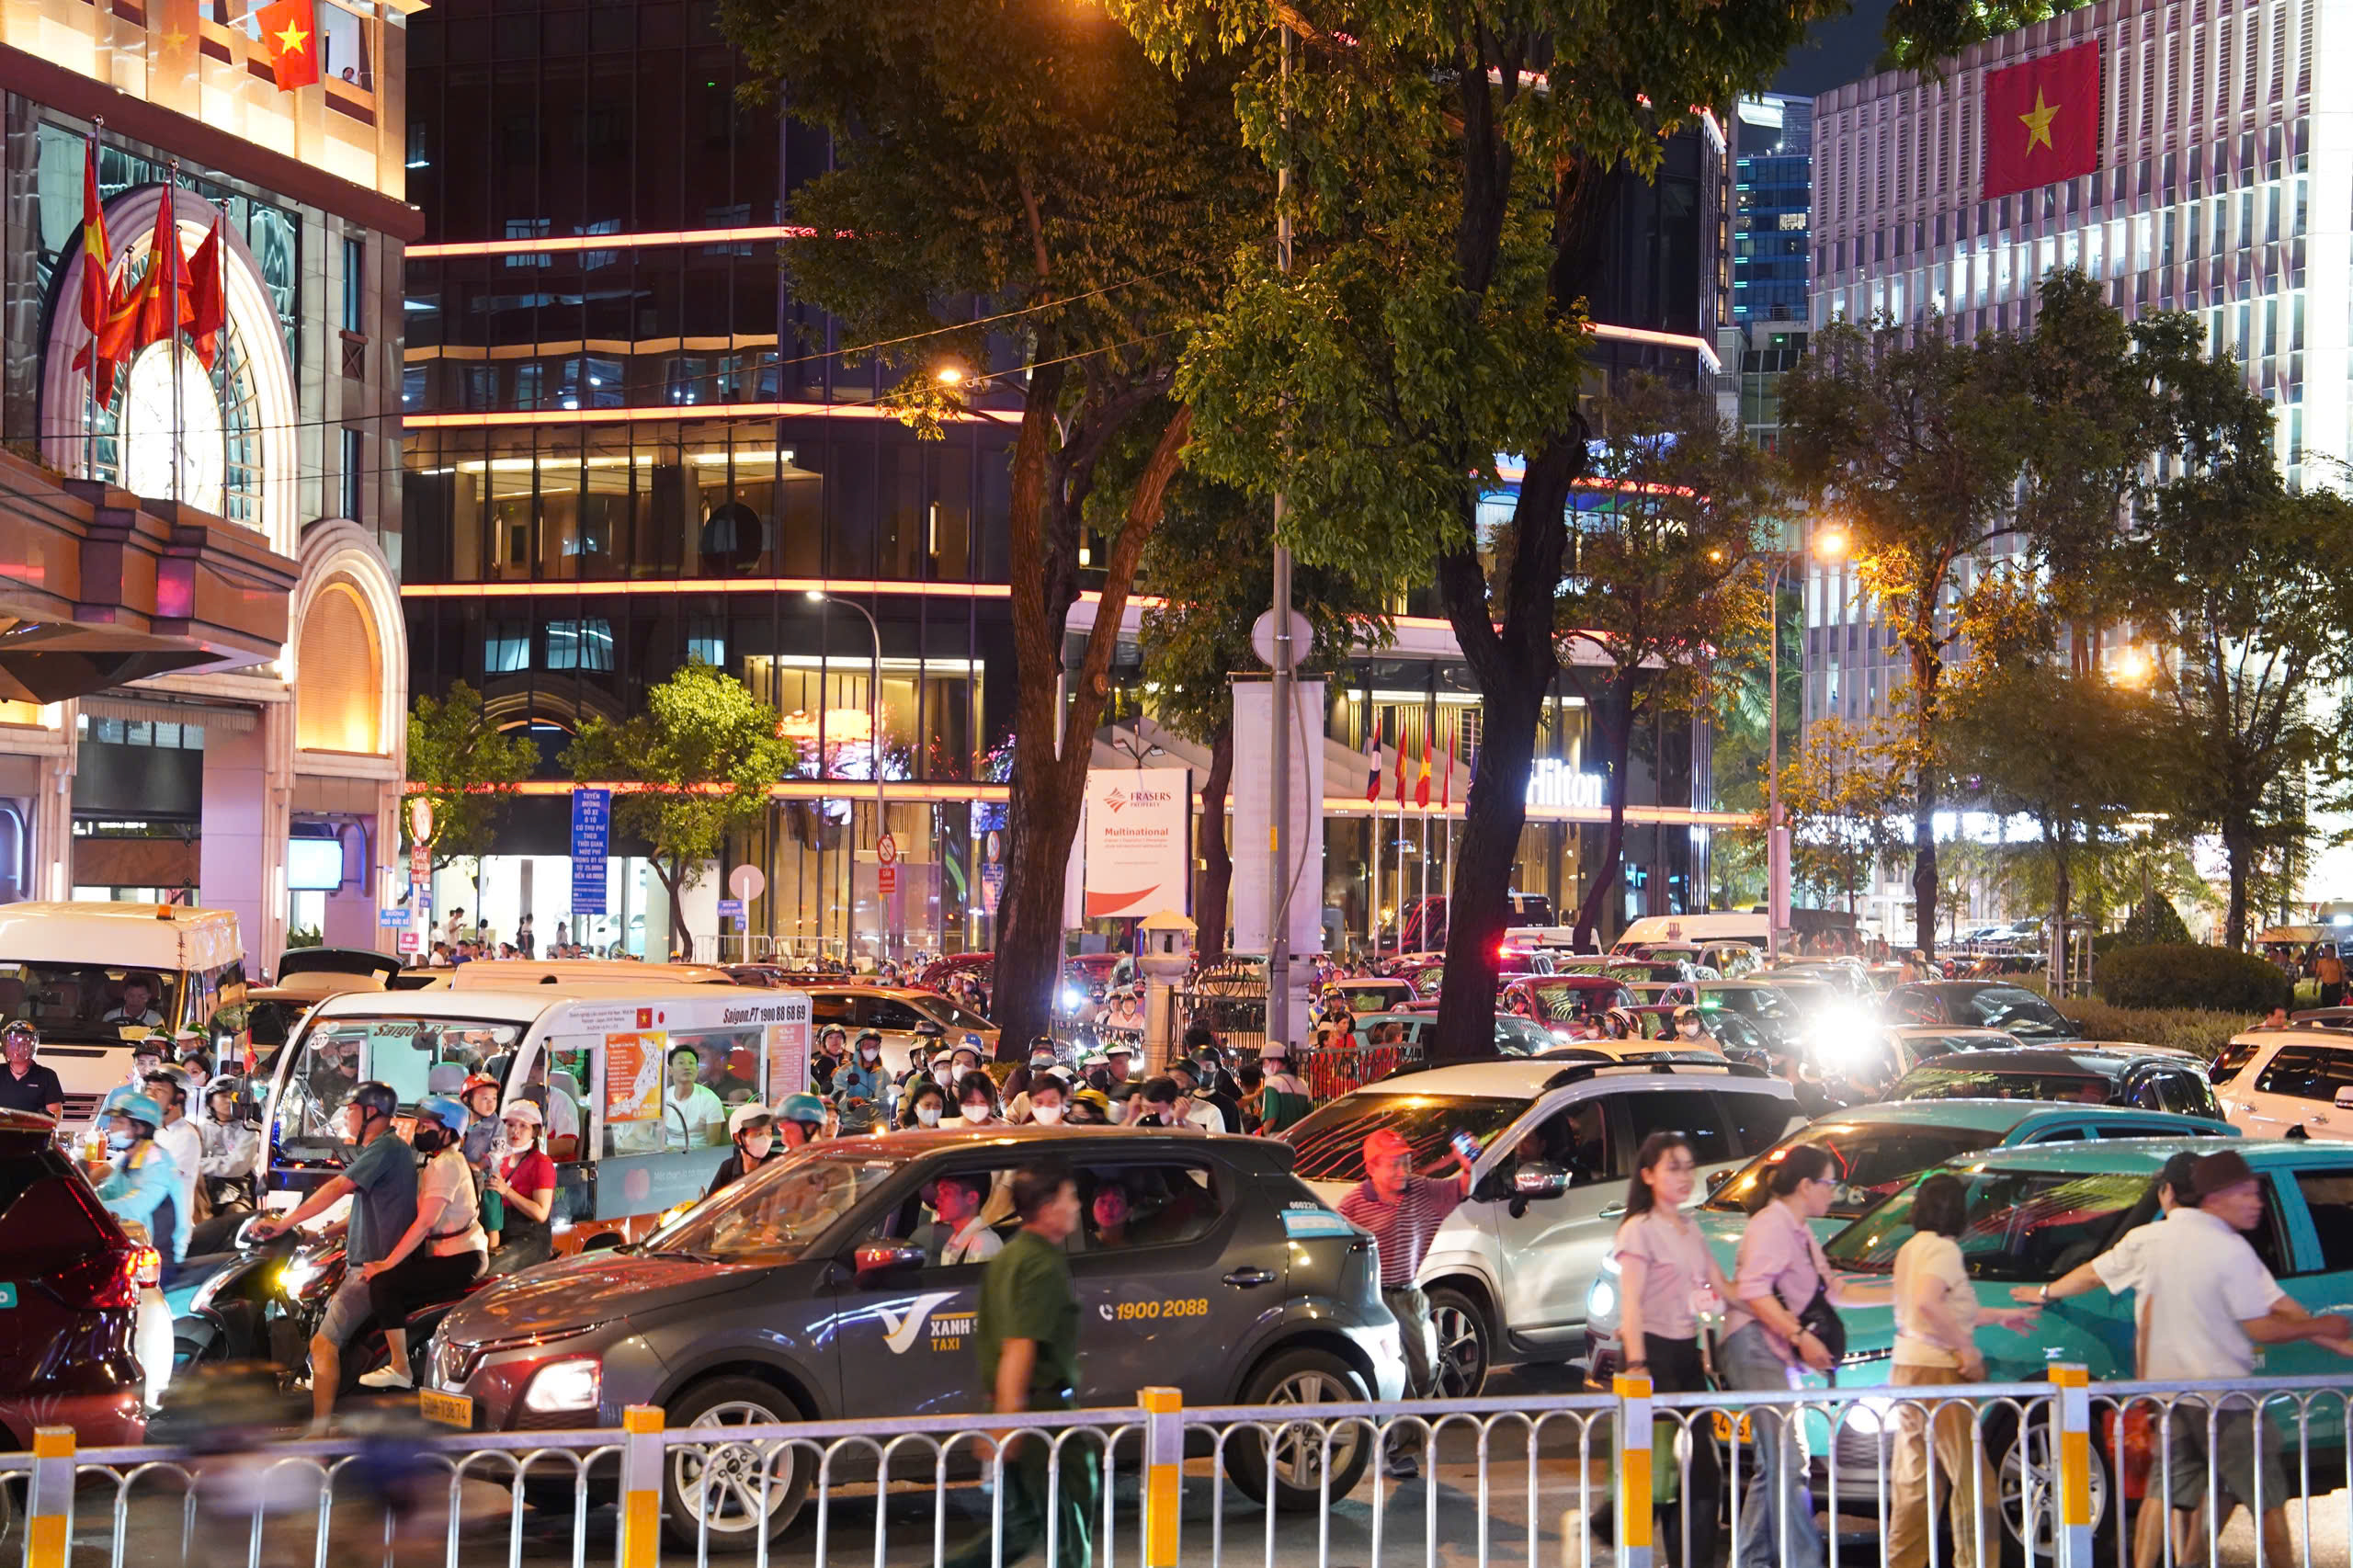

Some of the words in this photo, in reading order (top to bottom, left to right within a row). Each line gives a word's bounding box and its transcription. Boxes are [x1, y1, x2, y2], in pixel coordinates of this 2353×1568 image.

[1526, 757, 1603, 807] Hilton
[1131, 791, 1171, 801] FRASERS
[1105, 827, 1168, 836] Multinational
[761, 1008, 775, 1022] 1900
[777, 1006, 785, 1021] 88
[787, 1006, 795, 1020] 68
[797, 1005, 805, 1019] 69
[373, 1024, 420, 1038] Saigo
[1117, 1301, 1160, 1320] 1900
[1163, 1298, 1208, 1317] 2088
[931, 1319, 970, 1336] XANH
[931, 1338, 960, 1351] TAXI
